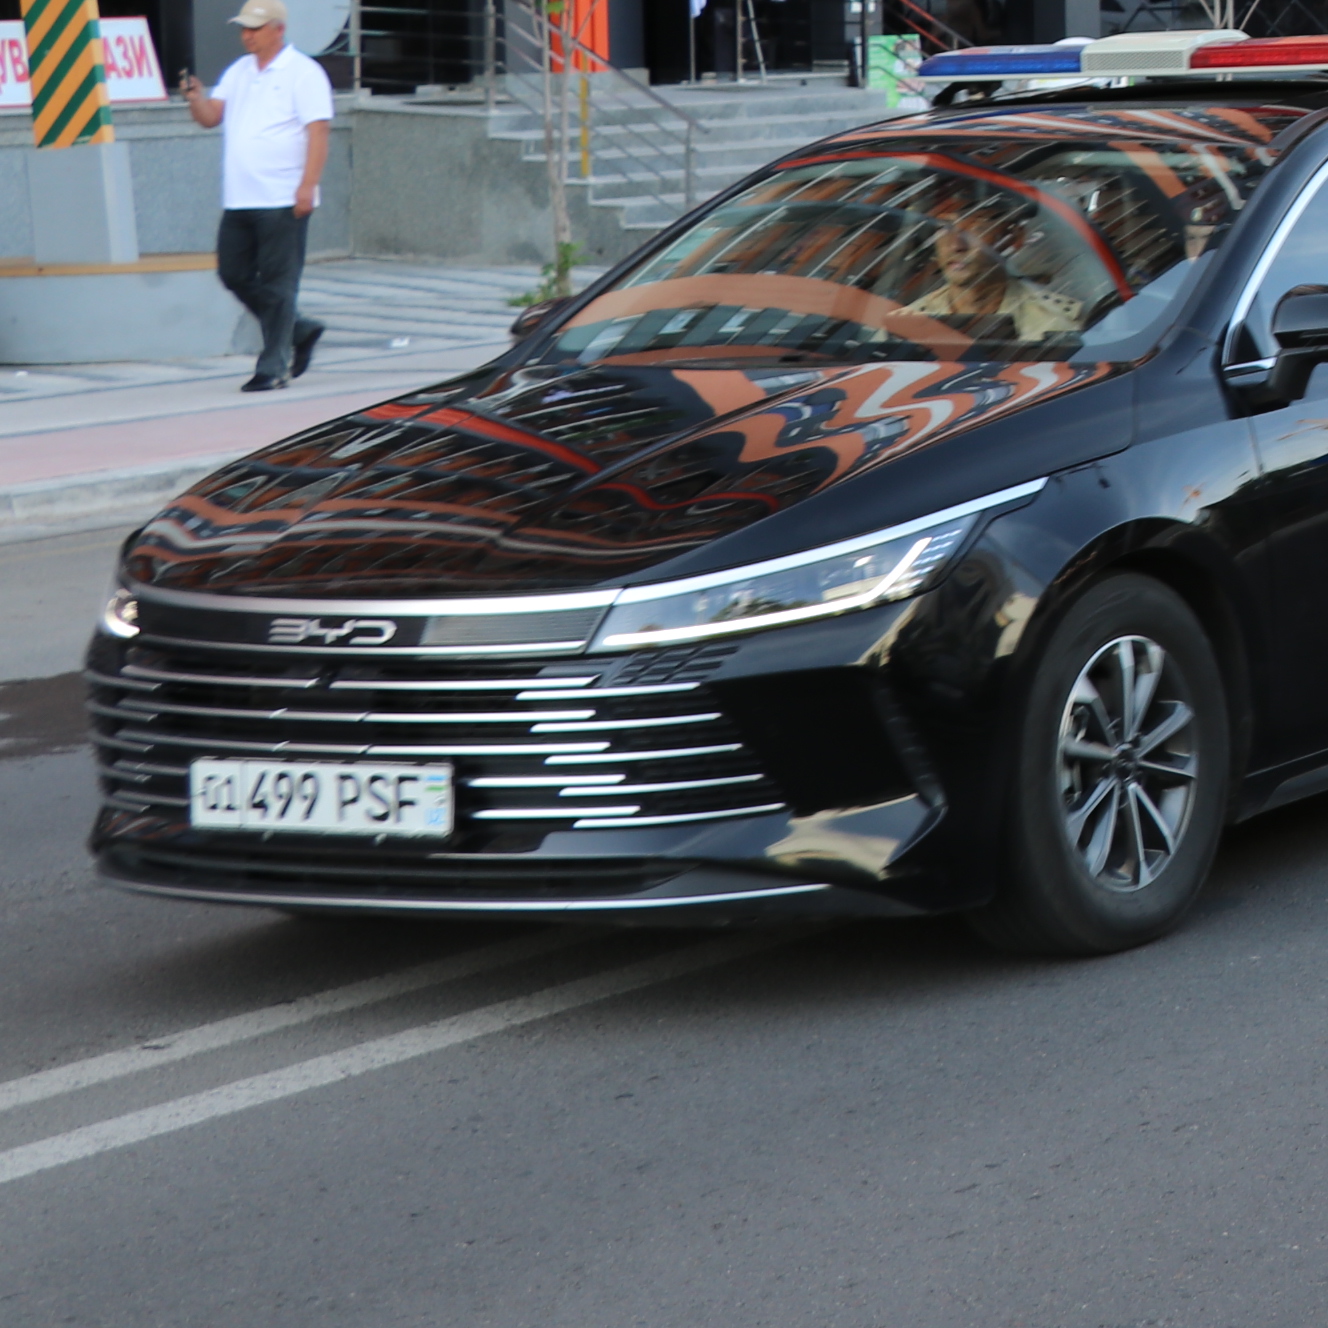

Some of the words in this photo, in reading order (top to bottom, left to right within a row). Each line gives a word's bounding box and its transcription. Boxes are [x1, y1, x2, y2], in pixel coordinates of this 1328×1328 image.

[268, 618, 398, 645] BYD
[203, 774, 237, 811] 01
[250, 770, 320, 821] 499
[337, 774, 419, 823] PSF
